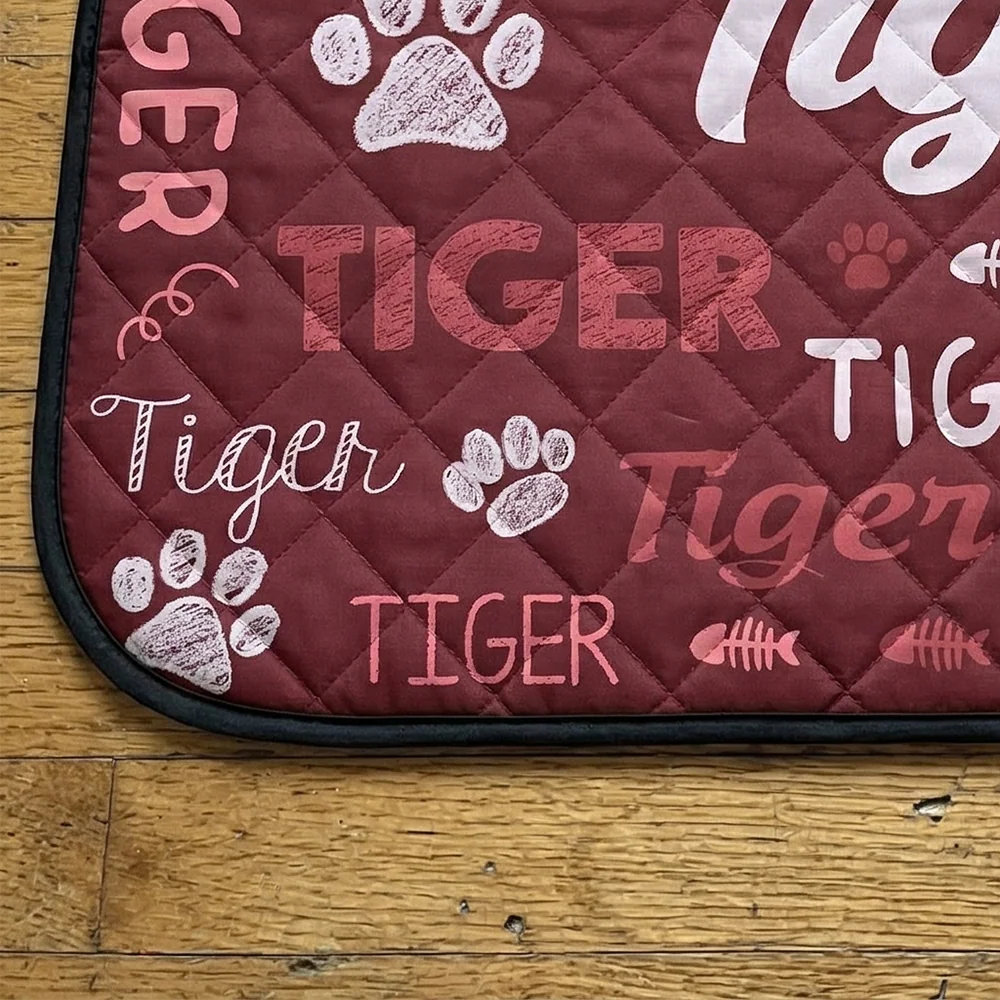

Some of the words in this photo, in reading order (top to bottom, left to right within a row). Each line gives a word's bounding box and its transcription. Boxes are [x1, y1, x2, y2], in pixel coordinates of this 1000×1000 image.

[277, 219, 781, 353] TIGER
[90, 393, 405, 543] Tiger
[619, 450, 996, 590] Tiger
[350, 592, 619, 687] TIGER
